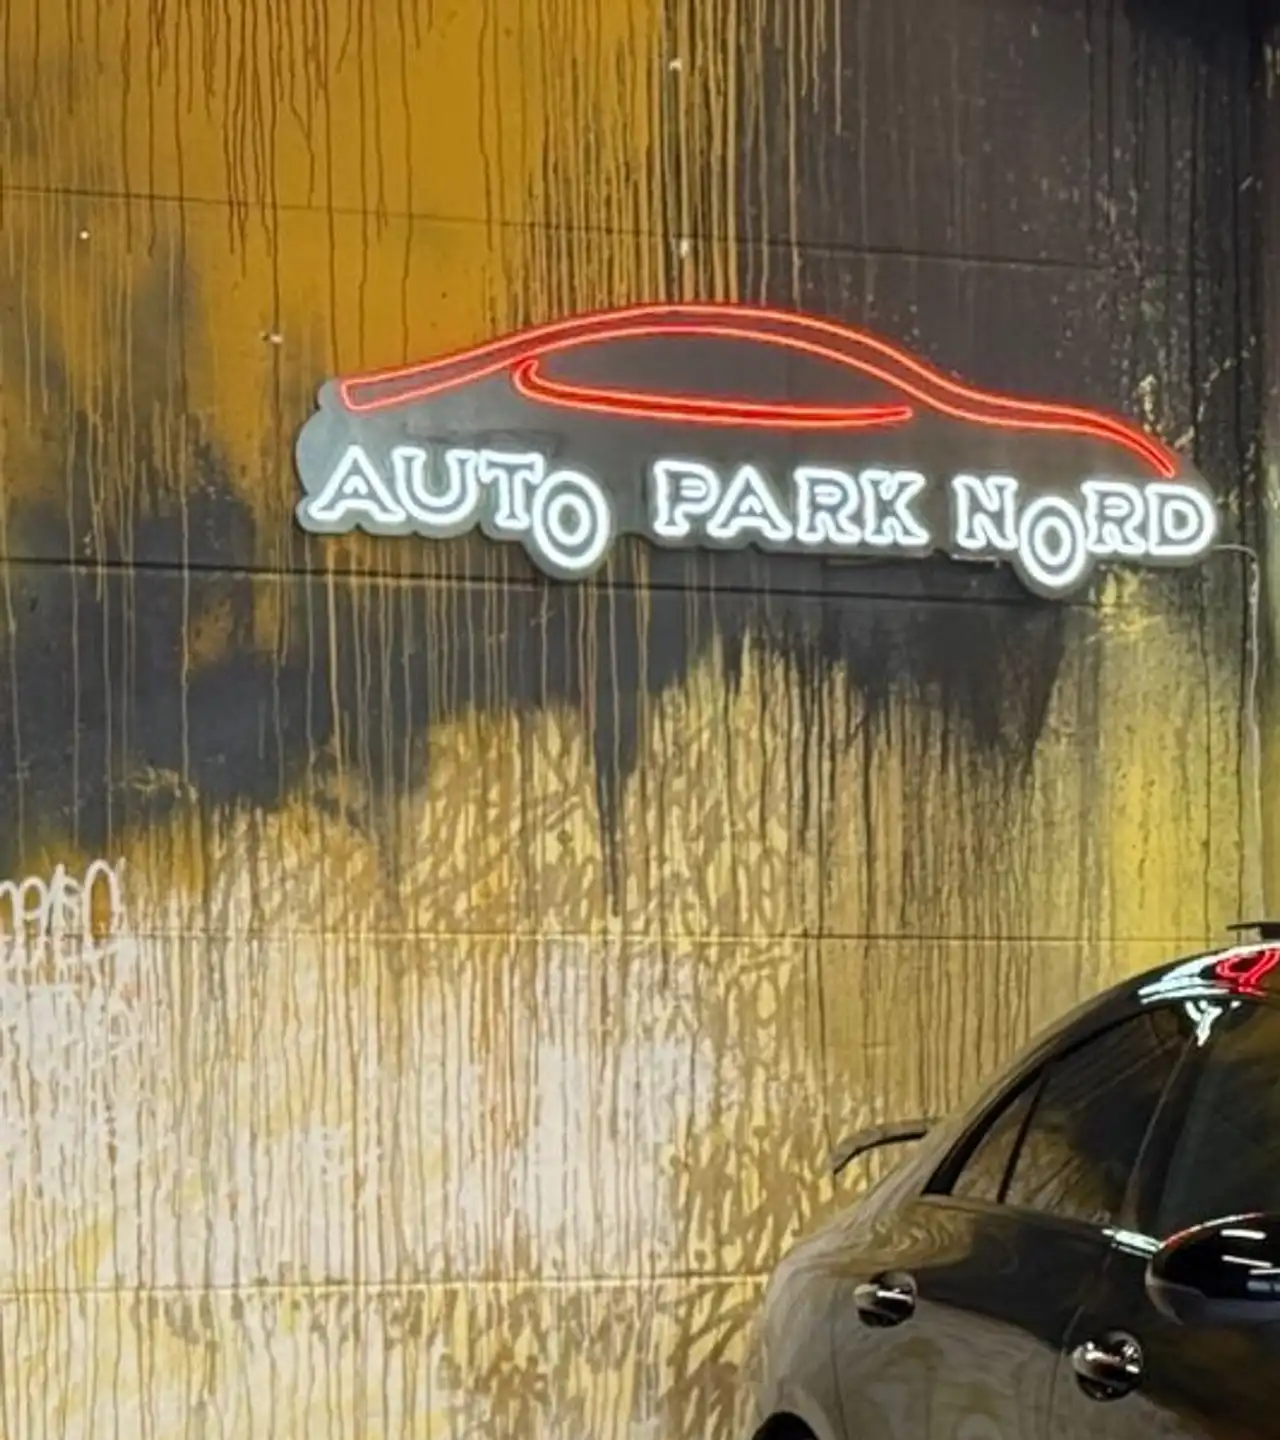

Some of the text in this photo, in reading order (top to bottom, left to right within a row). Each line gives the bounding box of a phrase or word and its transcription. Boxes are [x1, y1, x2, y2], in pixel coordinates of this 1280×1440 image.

[307, 444, 1217, 588] AUTO PARK NORD
